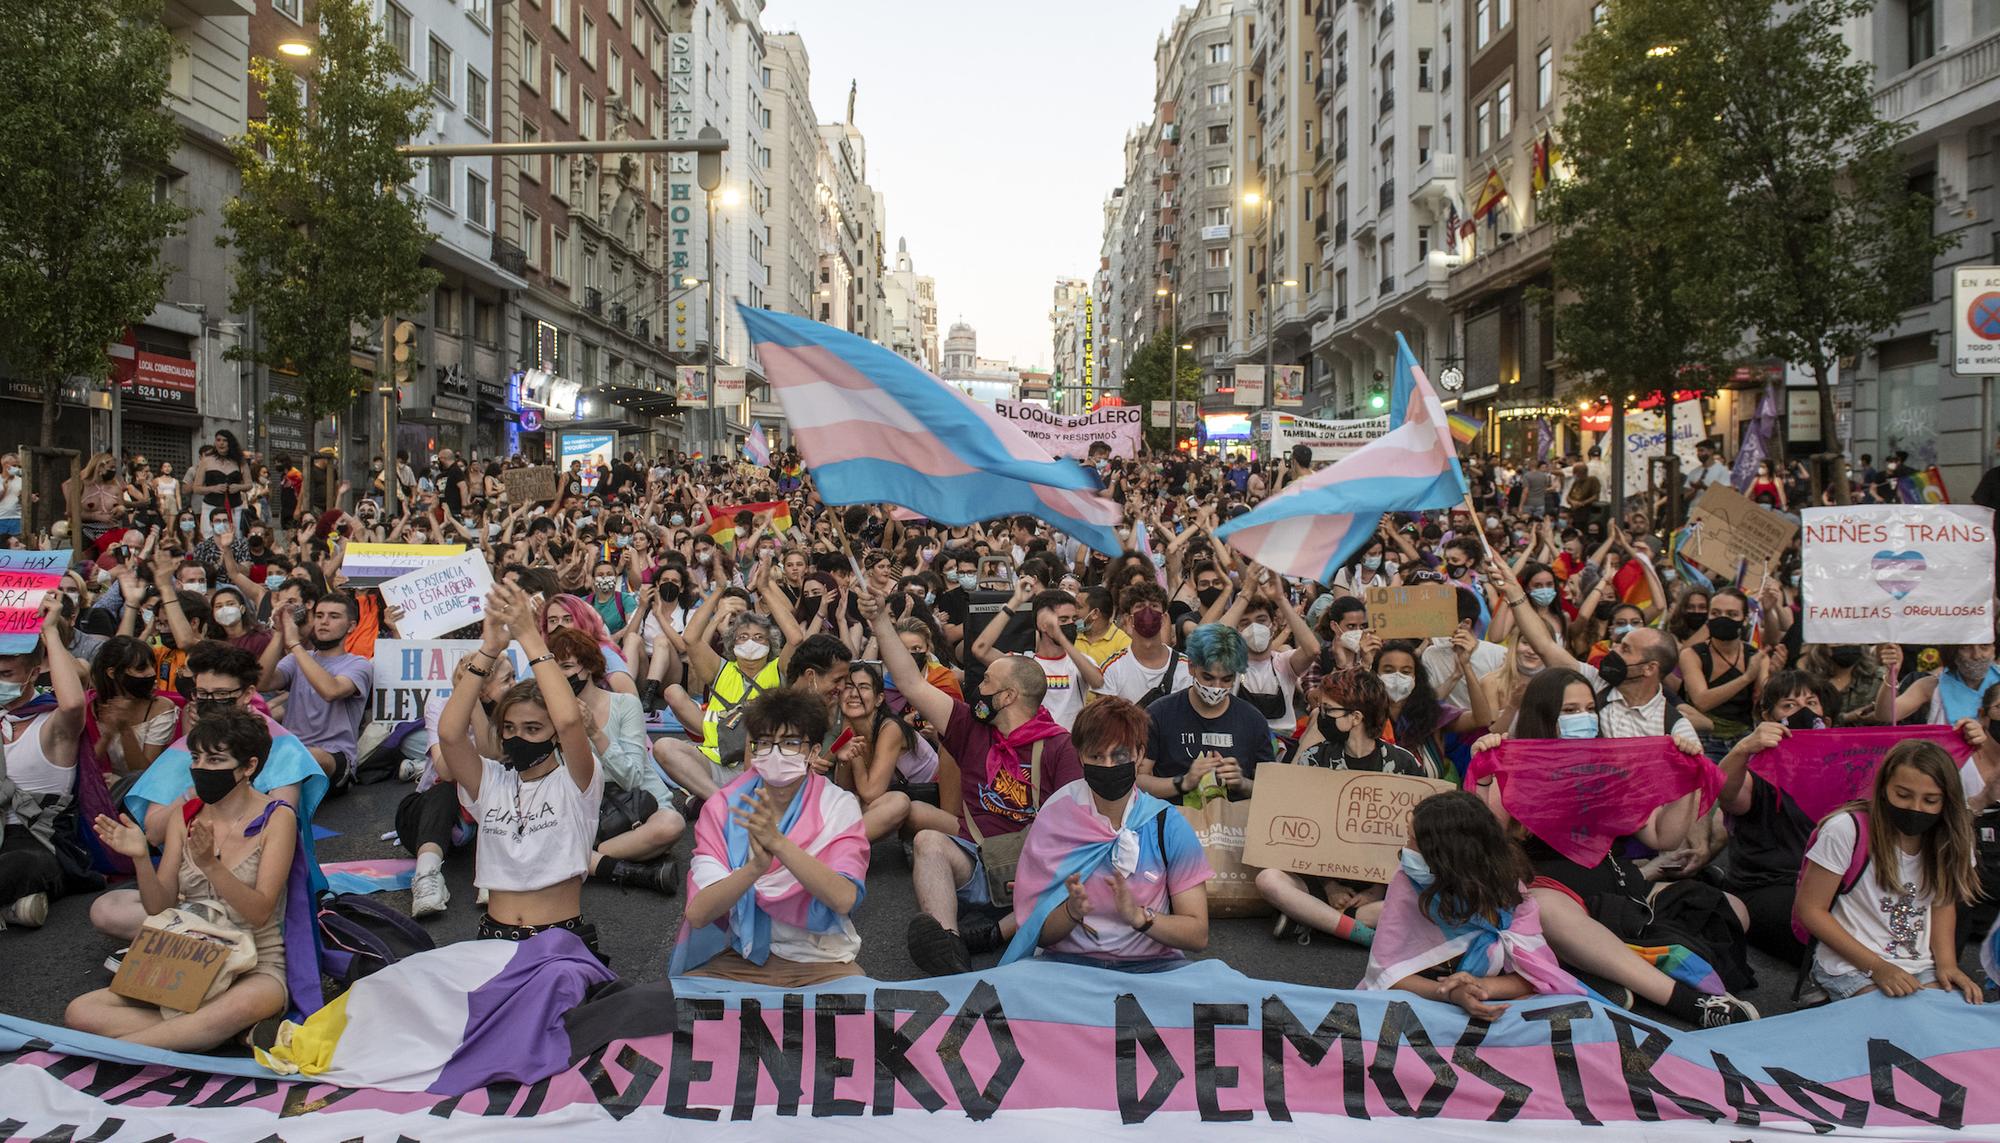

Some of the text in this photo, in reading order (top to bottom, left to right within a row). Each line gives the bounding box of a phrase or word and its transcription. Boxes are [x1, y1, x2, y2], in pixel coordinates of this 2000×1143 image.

[669, 35, 692, 174] SENATR
[670, 183, 691, 290] HOTEL
[1961, 279, 1977, 287] EN
[1085, 297, 1093, 340] HOTEL
[138, 359, 196, 379] LOCAL COMERCIALIZADO
[1958, 357, 1969, 365] DE
[138, 385, 155, 398] 524
[157, 387, 169, 399] 10
[170, 389, 182, 401] 99
[995, 403, 1141, 428] BLOQUE BOLLERO
[1582, 415, 1612, 424] VIP
[1022, 429, 1117, 442] TIMOS Y RESISTIMOS
[1320, 430, 1335, 439] SON
[1338, 430, 1363, 439] CLASE
[1806, 518, 1888, 544] NIÑES
[1904, 523, 1985, 543] TRANS
[22, 556, 58, 570] HAY
[414, 564, 467, 593] EXISTENCIA
[399, 599, 416, 613] NO
[433, 594, 470, 617] DEBATE
[1809, 604, 1986, 620] FAMILIAS ORGULLOSAS
[374, 687, 431, 721] LEY
[1181, 732, 1195, 745] I'M
[1350, 786, 1423, 807] ARE YOU
[1347, 803, 1361, 819] A
[1365, 803, 1403, 821] BOY
[1195, 821, 1247, 838] UMAN
[1281, 820, 1315, 841] NO.
[1345, 817, 1403, 838] A GIRL
[1291, 857, 1387, 881] LEY TRANS YA!
